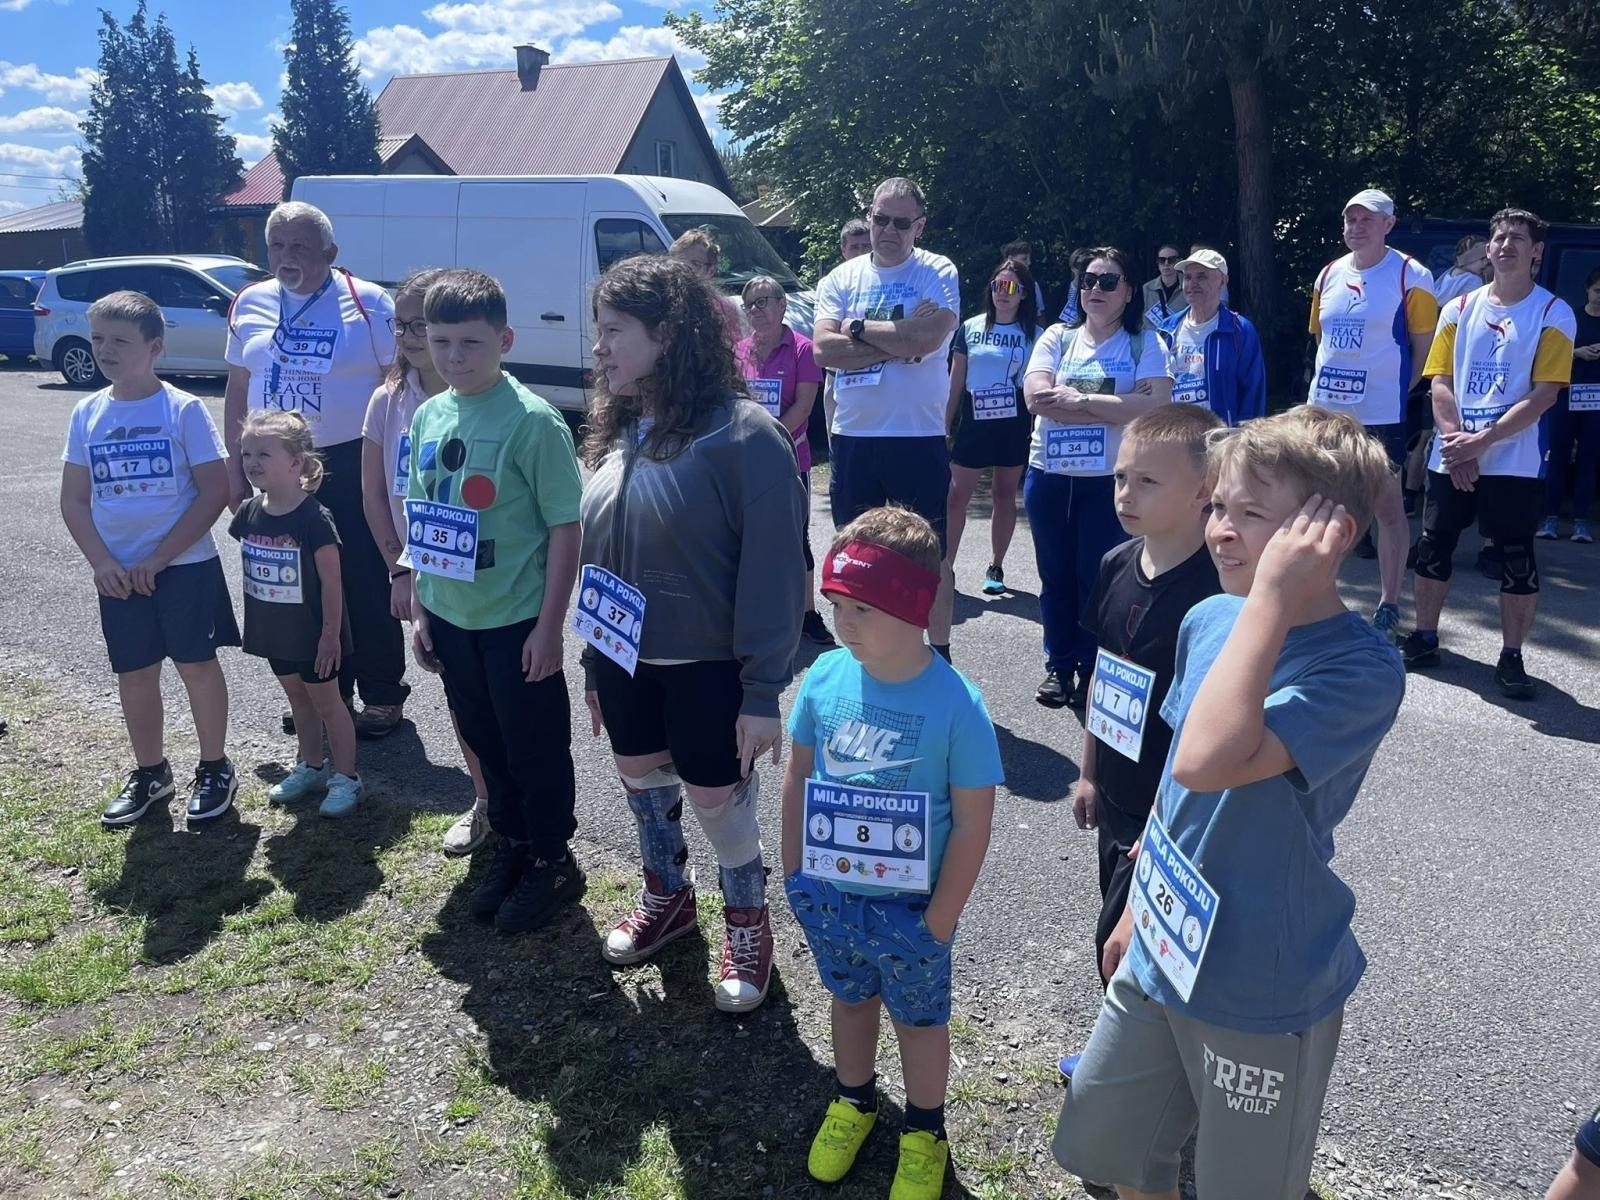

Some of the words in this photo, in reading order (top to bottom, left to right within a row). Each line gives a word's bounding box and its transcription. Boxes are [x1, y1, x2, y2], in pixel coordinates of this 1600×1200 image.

[973, 331, 1022, 348] BIEGAM
[1332, 327, 1365, 337] PEACE
[293, 342, 309, 351] 39
[1329, 336, 1363, 349] RUN
[1323, 367, 1336, 375] MILA
[1470, 371, 1509, 382] PEACE
[1466, 381, 1507, 395] RUN
[1180, 393, 1191, 401] 40
[1069, 429, 1101, 437] POKOJU
[93, 445, 118, 456] MILA
[120, 441, 165, 453] POKOJU
[1068, 443, 1082, 452] 34
[121, 461, 139, 473] 17
[411, 503, 435, 517] MILA
[436, 507, 475, 524] POKOJU
[431, 528, 448, 544] 35
[255, 548, 294, 560] POKOJU
[256, 566, 270, 577] 19
[589, 568, 615, 592] MILA
[616, 583, 645, 611] POKOJ
[607, 606, 627, 625] 37
[1099, 657, 1115, 676] MILA
[1115, 665, 1147, 690] POKOJU
[1113, 693, 1121, 709] 7
[828, 719, 903, 762] NIKE
[813, 788, 849, 806] MILA
[852, 794, 919, 812] POKOJU
[856, 824, 870, 843] 8
[1150, 823, 1168, 861] MILA
[1166, 853, 1211, 912] POKOJU
[1155, 883, 1175, 916] 26
[1203, 1043, 1285, 1101] FREE
[1225, 1093, 1277, 1115] WOLF
